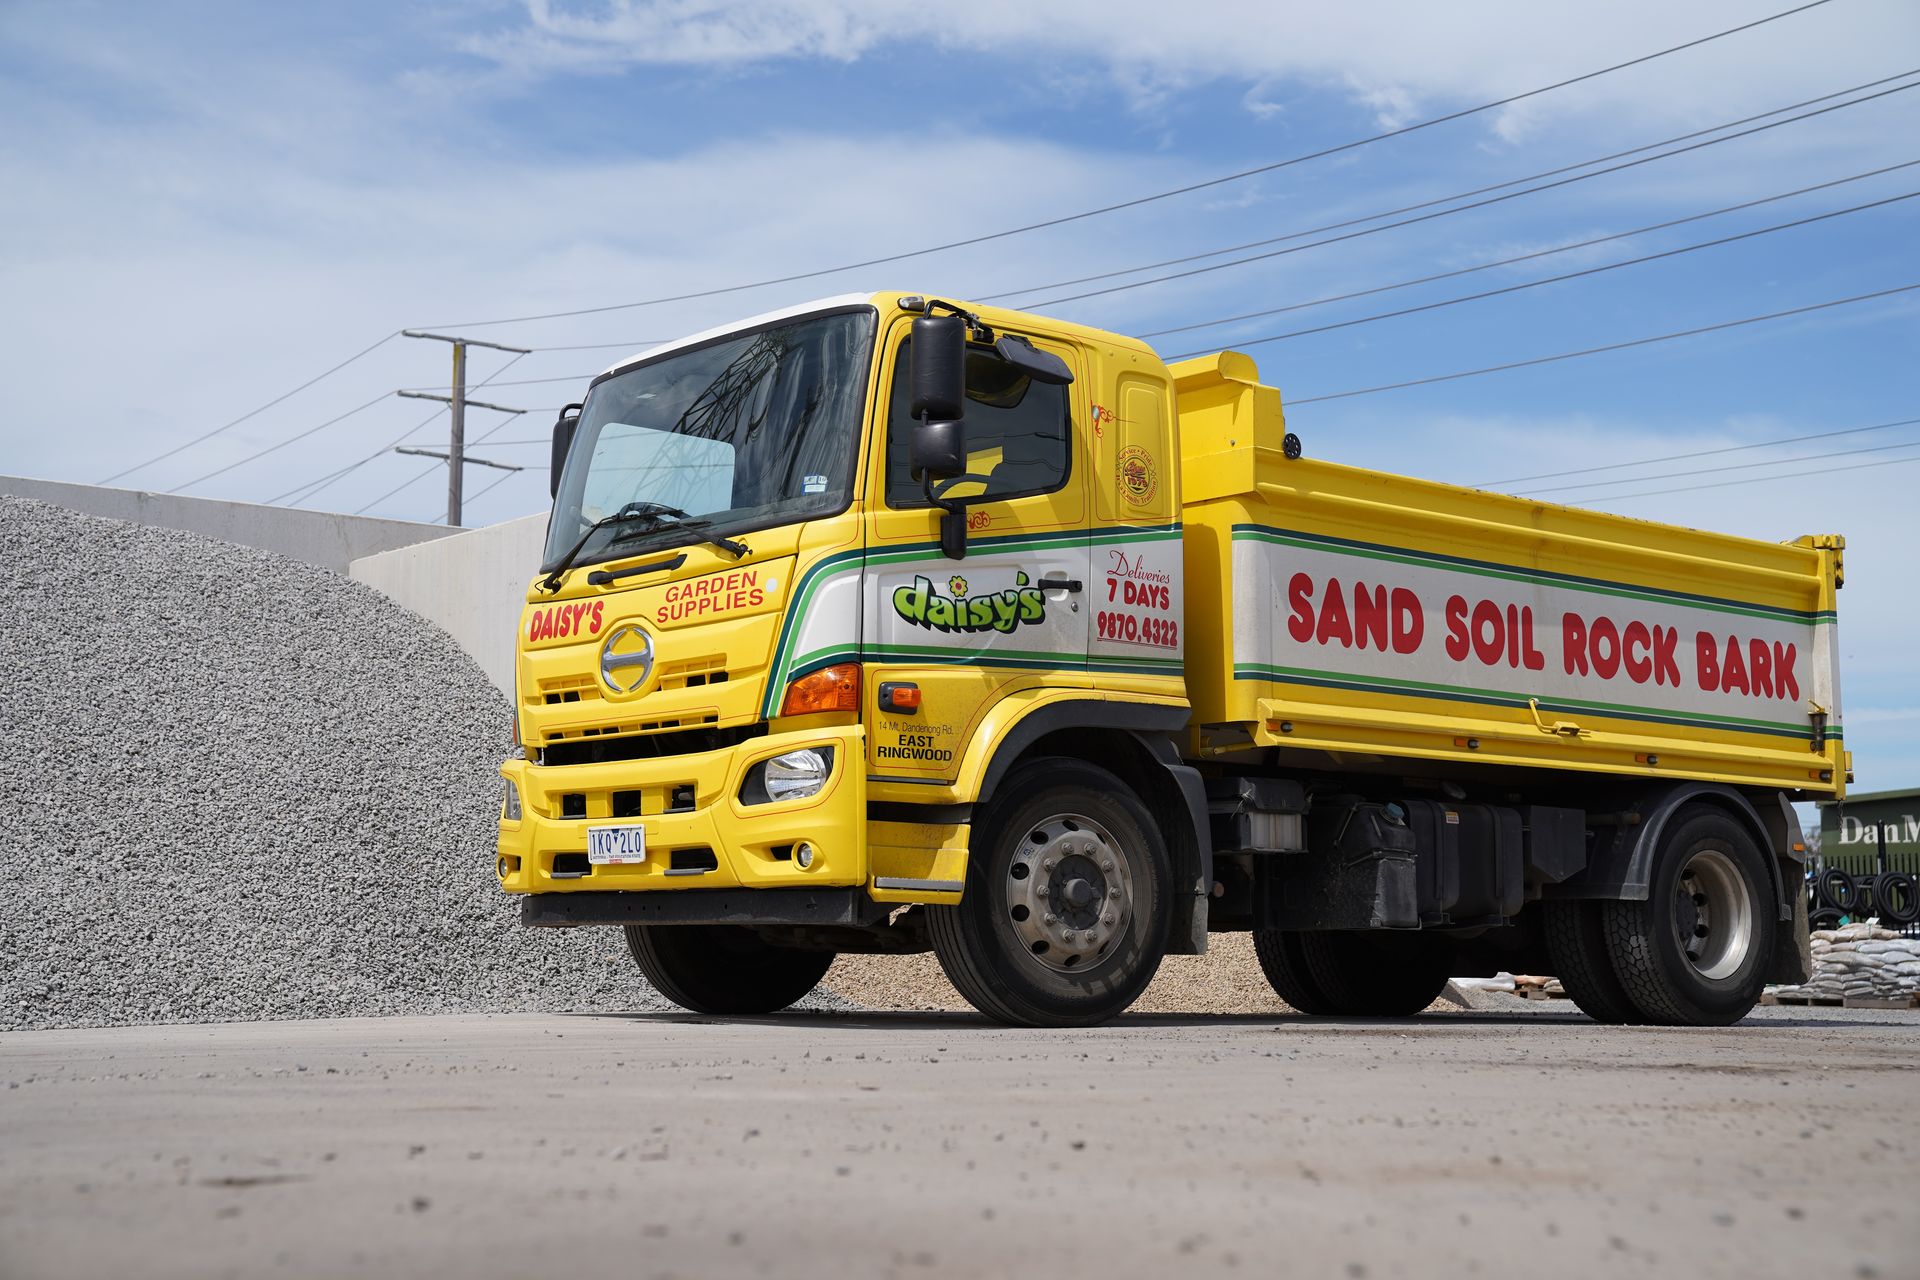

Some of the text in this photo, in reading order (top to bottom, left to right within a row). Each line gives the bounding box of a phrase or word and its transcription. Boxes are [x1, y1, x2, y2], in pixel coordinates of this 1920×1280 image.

[1106, 549, 1170, 584] Deliveries
[665, 570, 758, 603] GARDEN
[892, 570, 1046, 634] daisy's
[1106, 578, 1170, 611] 7 DAYS
[529, 600, 605, 643] DAISY'S
[656, 588, 764, 624] SUPPLIES
[1096, 611, 1178, 647] 9870.4322
[1287, 571, 1801, 703] SAND SOIL ROCK BARK
[879, 721, 887, 730] 14
[902, 722, 941, 736] Dandenong
[898, 734, 934, 748] EAST
[877, 746, 952, 762] RINGWOOD
[592, 832, 611, 855] 1KQ
[1838, 816, 1900, 845] Dan
